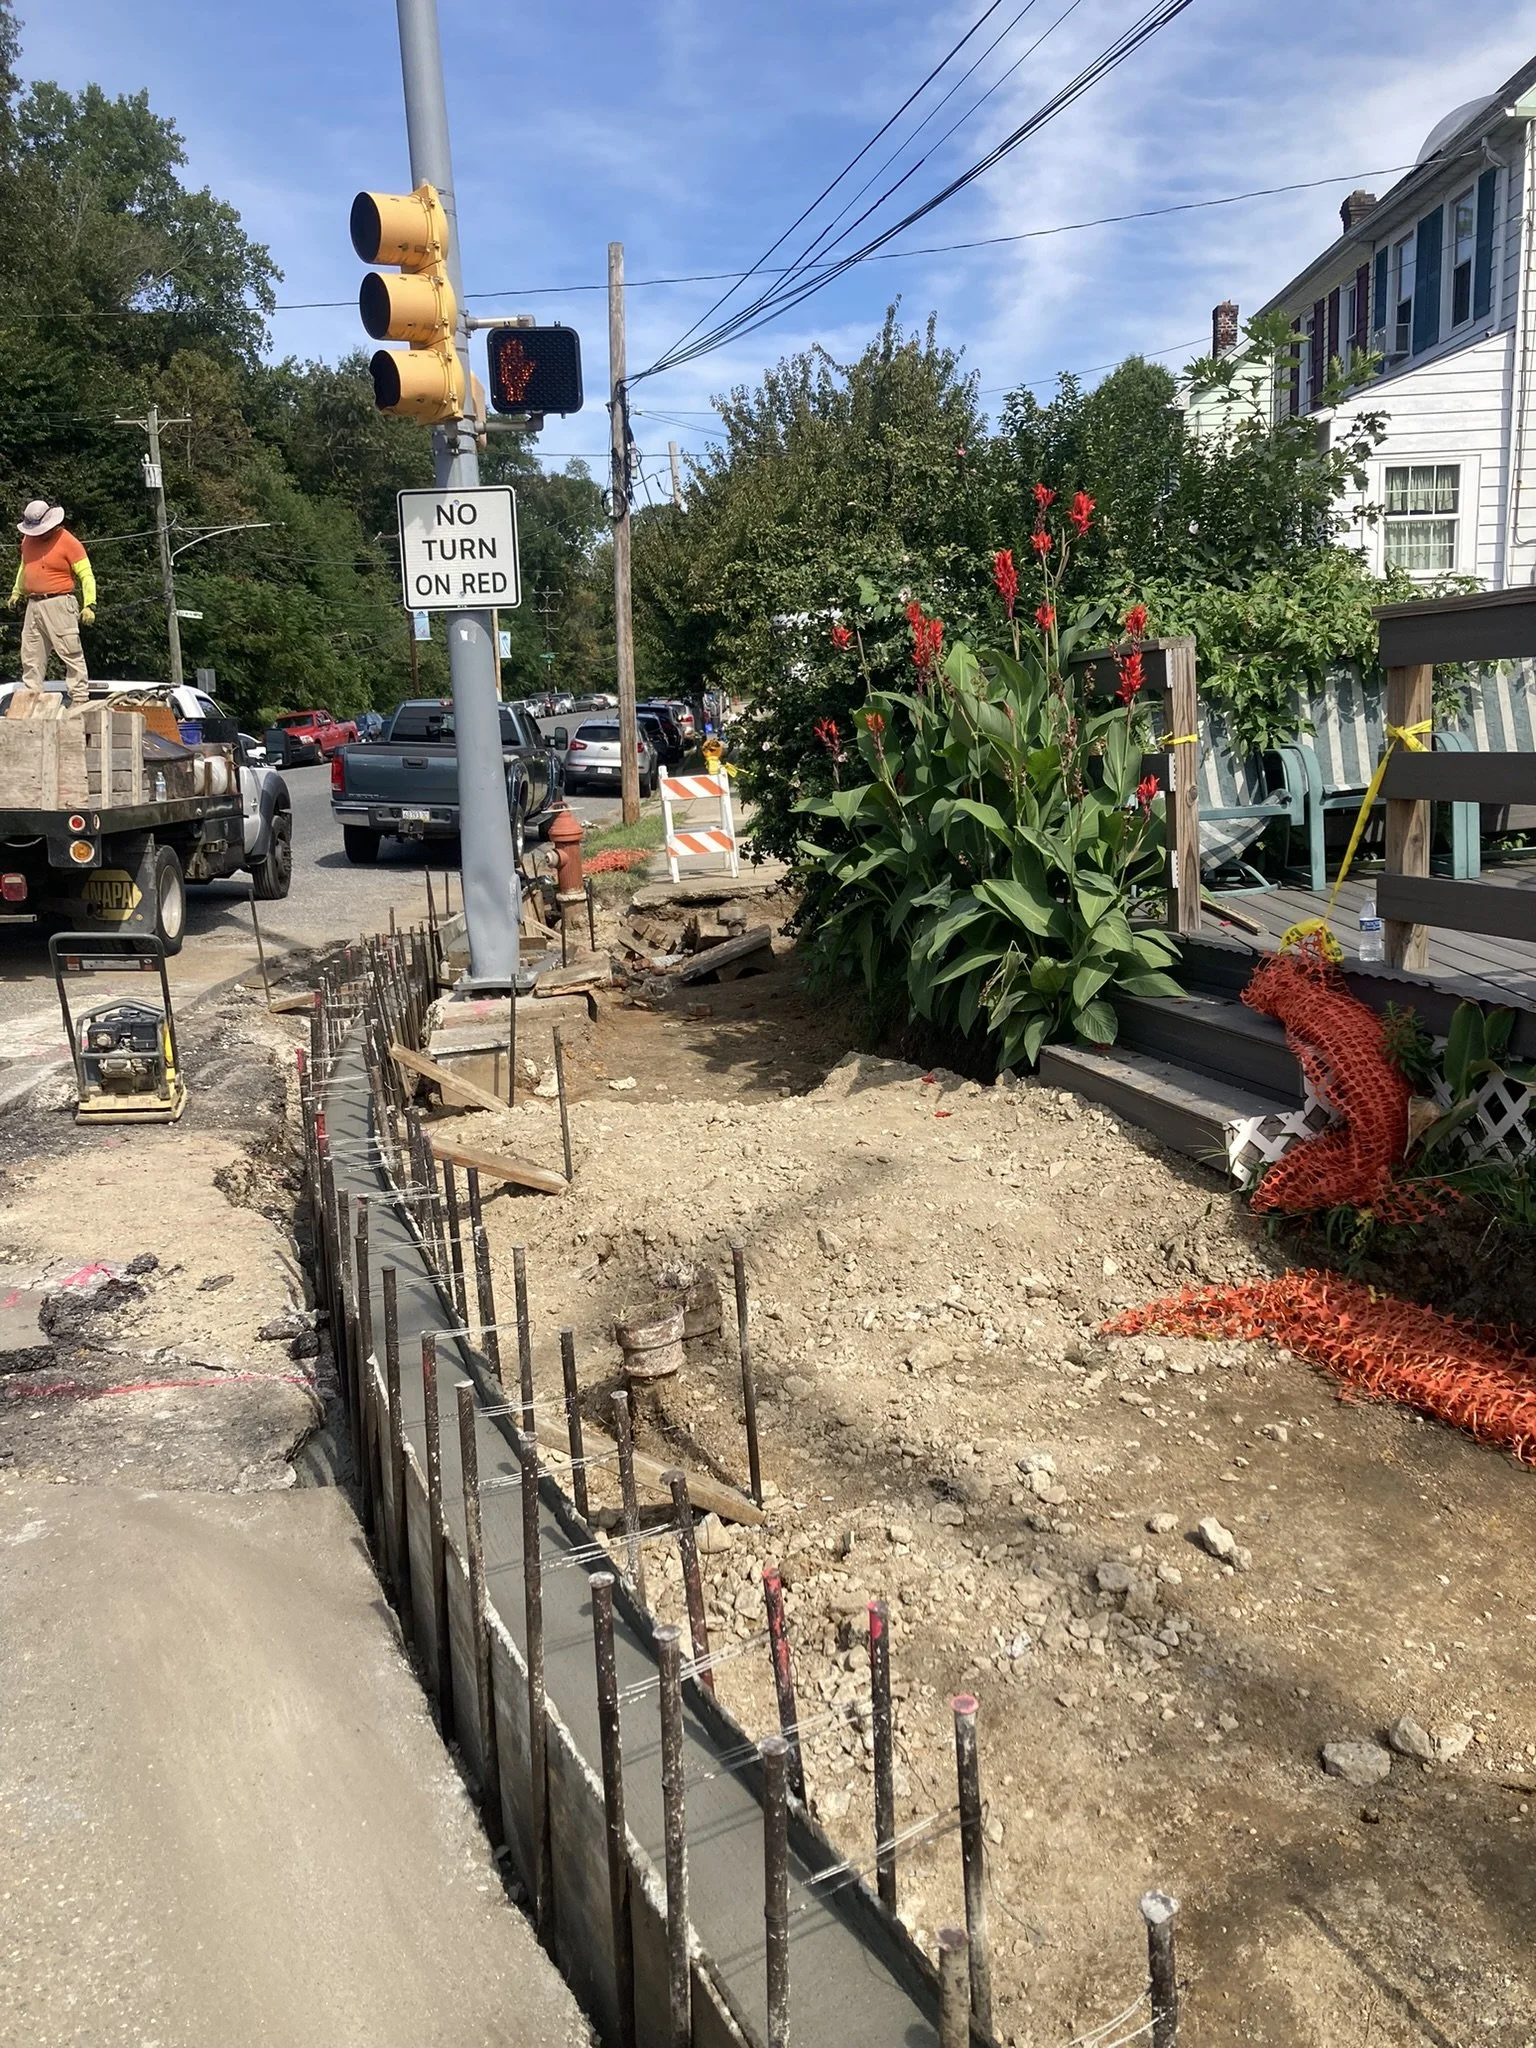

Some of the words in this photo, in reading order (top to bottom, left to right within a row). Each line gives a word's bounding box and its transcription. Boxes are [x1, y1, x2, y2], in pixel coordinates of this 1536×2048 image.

[436, 503, 477, 526] NO
[422, 538, 497, 561] TURN
[416, 574, 451, 596] ON
[461, 572, 508, 594] RED
[88, 881, 134, 909] NAPA
